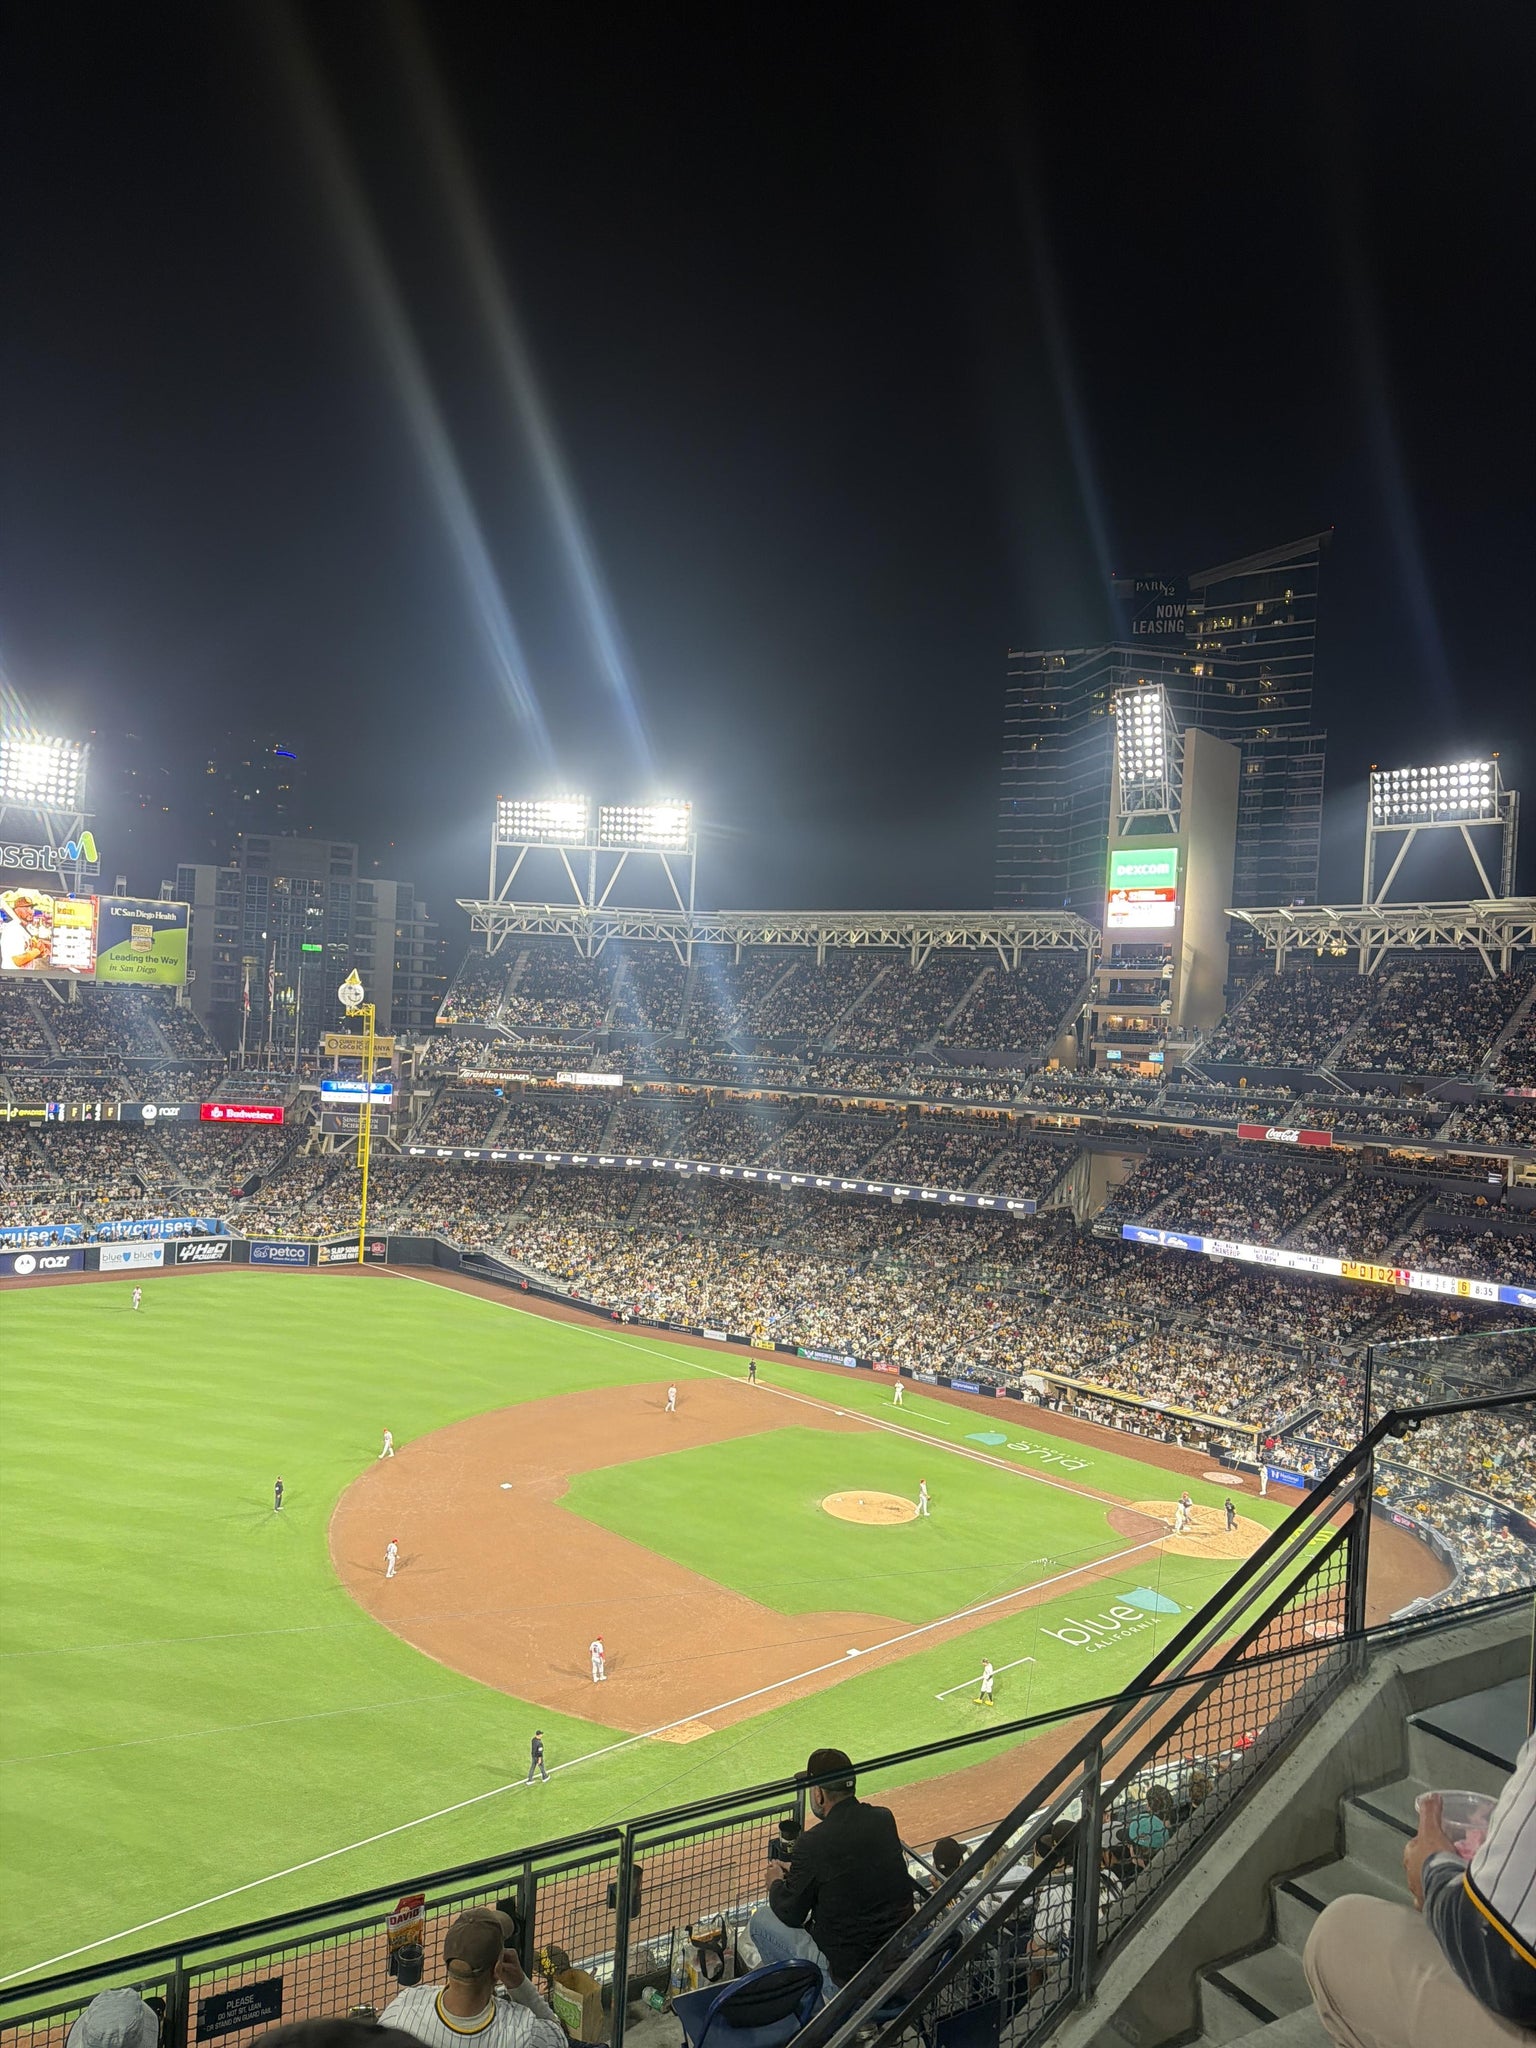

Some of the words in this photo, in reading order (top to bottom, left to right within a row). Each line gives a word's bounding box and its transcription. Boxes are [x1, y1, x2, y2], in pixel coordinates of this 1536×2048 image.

[1156, 604, 1186, 618] NOW
[1132, 619, 1185, 634] LEASING
[0, 845, 56, 871] sat
[110, 907, 121, 916] UC
[122, 908, 136, 917] San
[136, 909, 155, 920] Diego
[155, 911, 177, 920] Health
[109, 953, 144, 963] Leading
[145, 954, 159, 963] the
[160, 956, 179, 966] Way
[109, 963, 117, 971] in
[136, 965, 157, 974] Diego
[460, 1068, 499, 1079] Tarantino
[499, 1072, 530, 1080] SAUSAGES
[71, 1107, 78, 1117] F
[107, 1107, 114, 1117] F
[226, 1108, 275, 1120] Budweiser
[101, 1220, 193, 1236] citycruises
[102, 1252, 122, 1261] blue
[133, 1250, 154, 1259] blue
[192, 1252, 223, 1261] POWER
[269, 1246, 306, 1259] petco
[39, 1255, 71, 1269] razr
[1461, 1281, 1467, 1291] 6
[1475, 1286, 1493, 1297] 8:35
[1007, 1442, 1089, 1471] blue
[1039, 1606, 1144, 1646] blue
[1085, 1617, 1162, 1653] CALIFORNIA
[389, 1908, 420, 1926] DAVID
[226, 1994, 255, 2010] PLEASE
[217, 2012, 226, 2021] DO
[226, 2009, 237, 2018] NOT
[248, 2002, 262, 2012] LEAN
[206, 2024, 215, 2032] OR
[214, 2018, 233, 2030] STAND
[232, 2016, 242, 2024] ON
[241, 2011, 260, 2022] GUARD
[260, 2007, 272, 2016] RAIL
